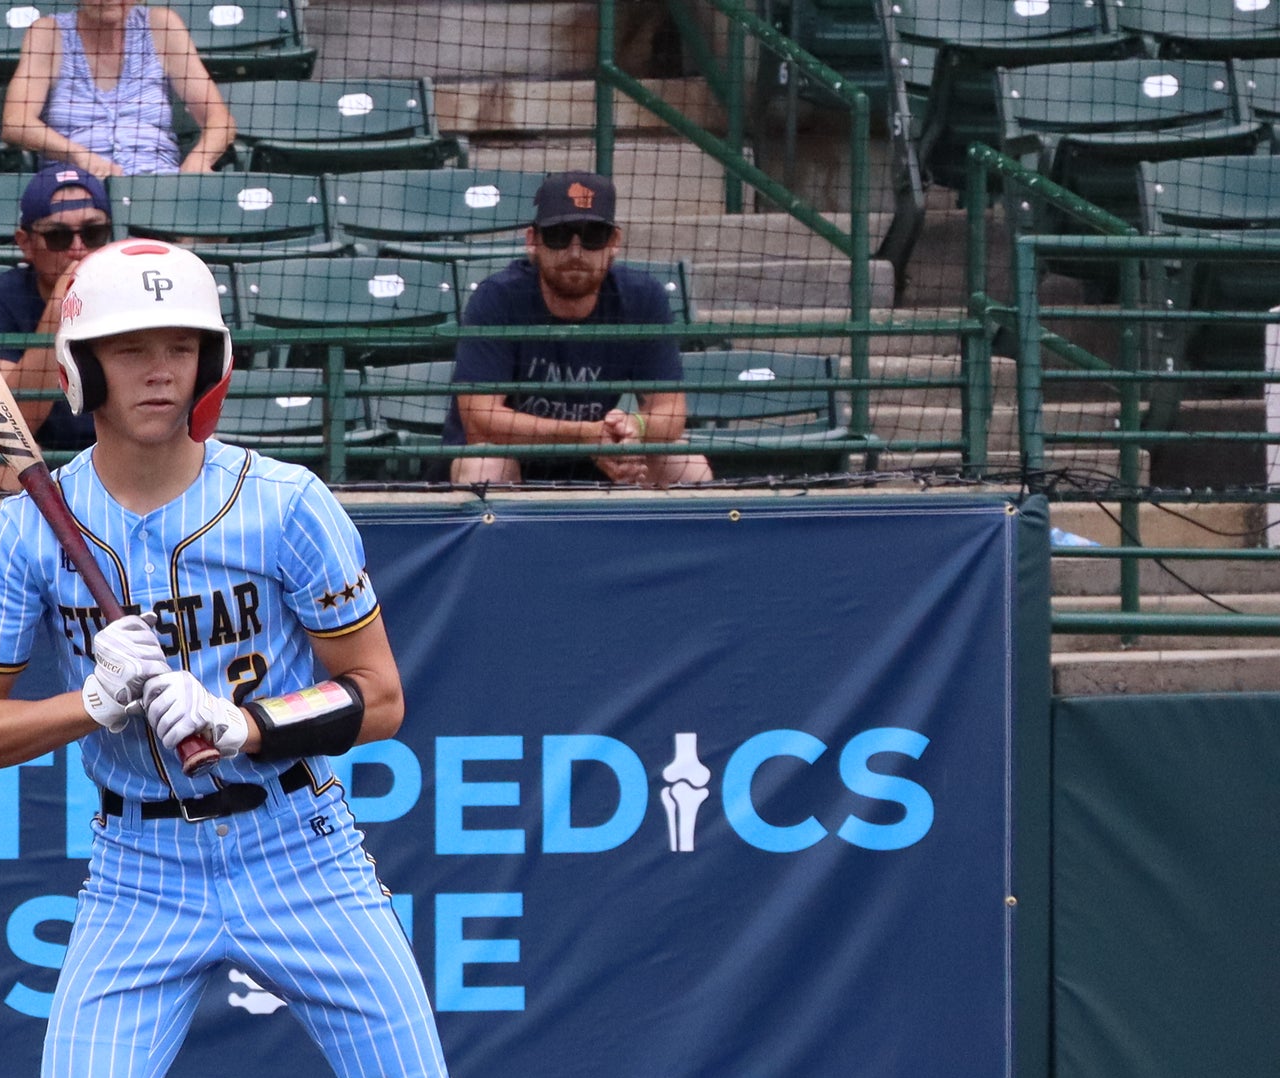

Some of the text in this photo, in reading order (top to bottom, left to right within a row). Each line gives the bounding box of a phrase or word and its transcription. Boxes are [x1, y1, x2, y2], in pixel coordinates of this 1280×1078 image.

[142, 270, 173, 301] CP
[0, 401, 32, 449] marucci
[152, 581, 262, 658] STAR
[226, 651, 269, 707] 2
